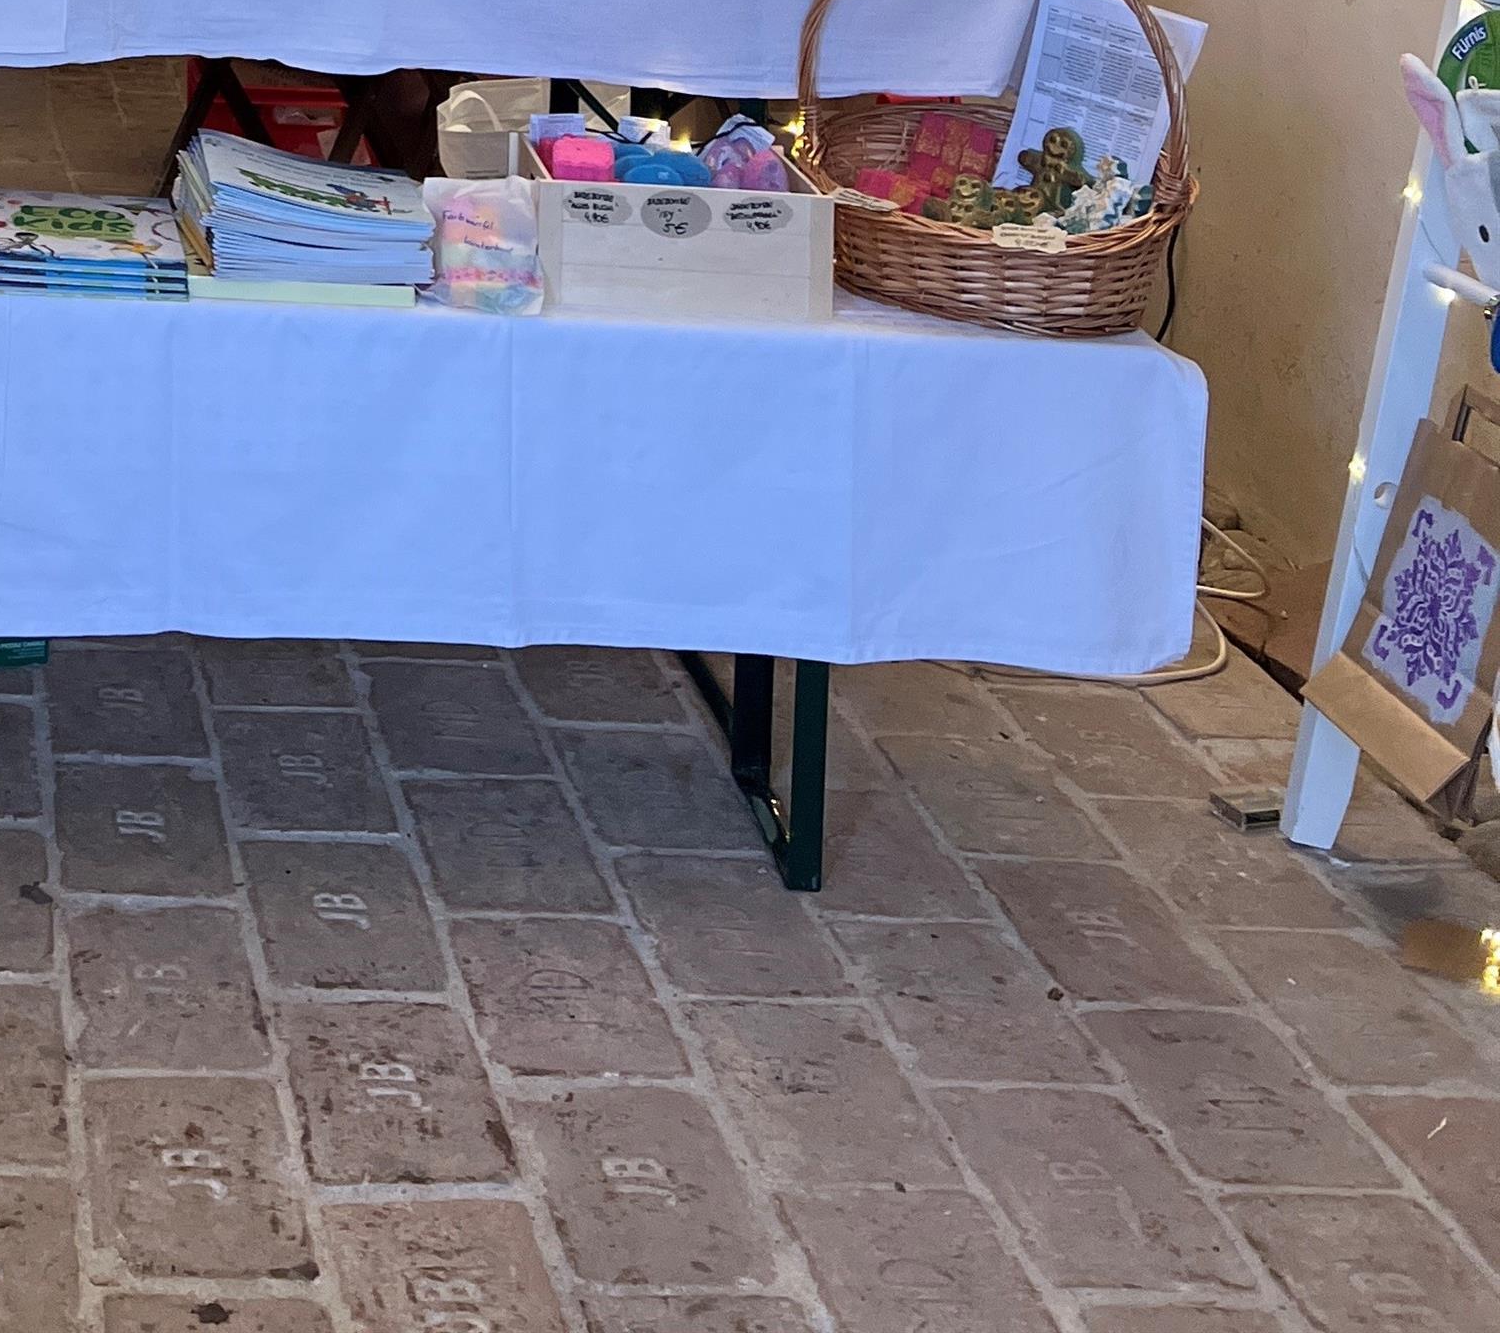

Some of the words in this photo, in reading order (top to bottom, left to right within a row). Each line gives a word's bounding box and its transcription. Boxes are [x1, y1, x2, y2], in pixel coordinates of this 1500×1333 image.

[13, 216, 135, 233] Kids
[20, 205, 126, 220] ECO
[277, 751, 329, 787] JB
[115, 809, 167, 844] JB
[312, 890, 373, 930] JB
[359, 1062, 432, 1112] JB
[161, 1147, 229, 1203] JB
[601, 1155, 679, 1206] JB
